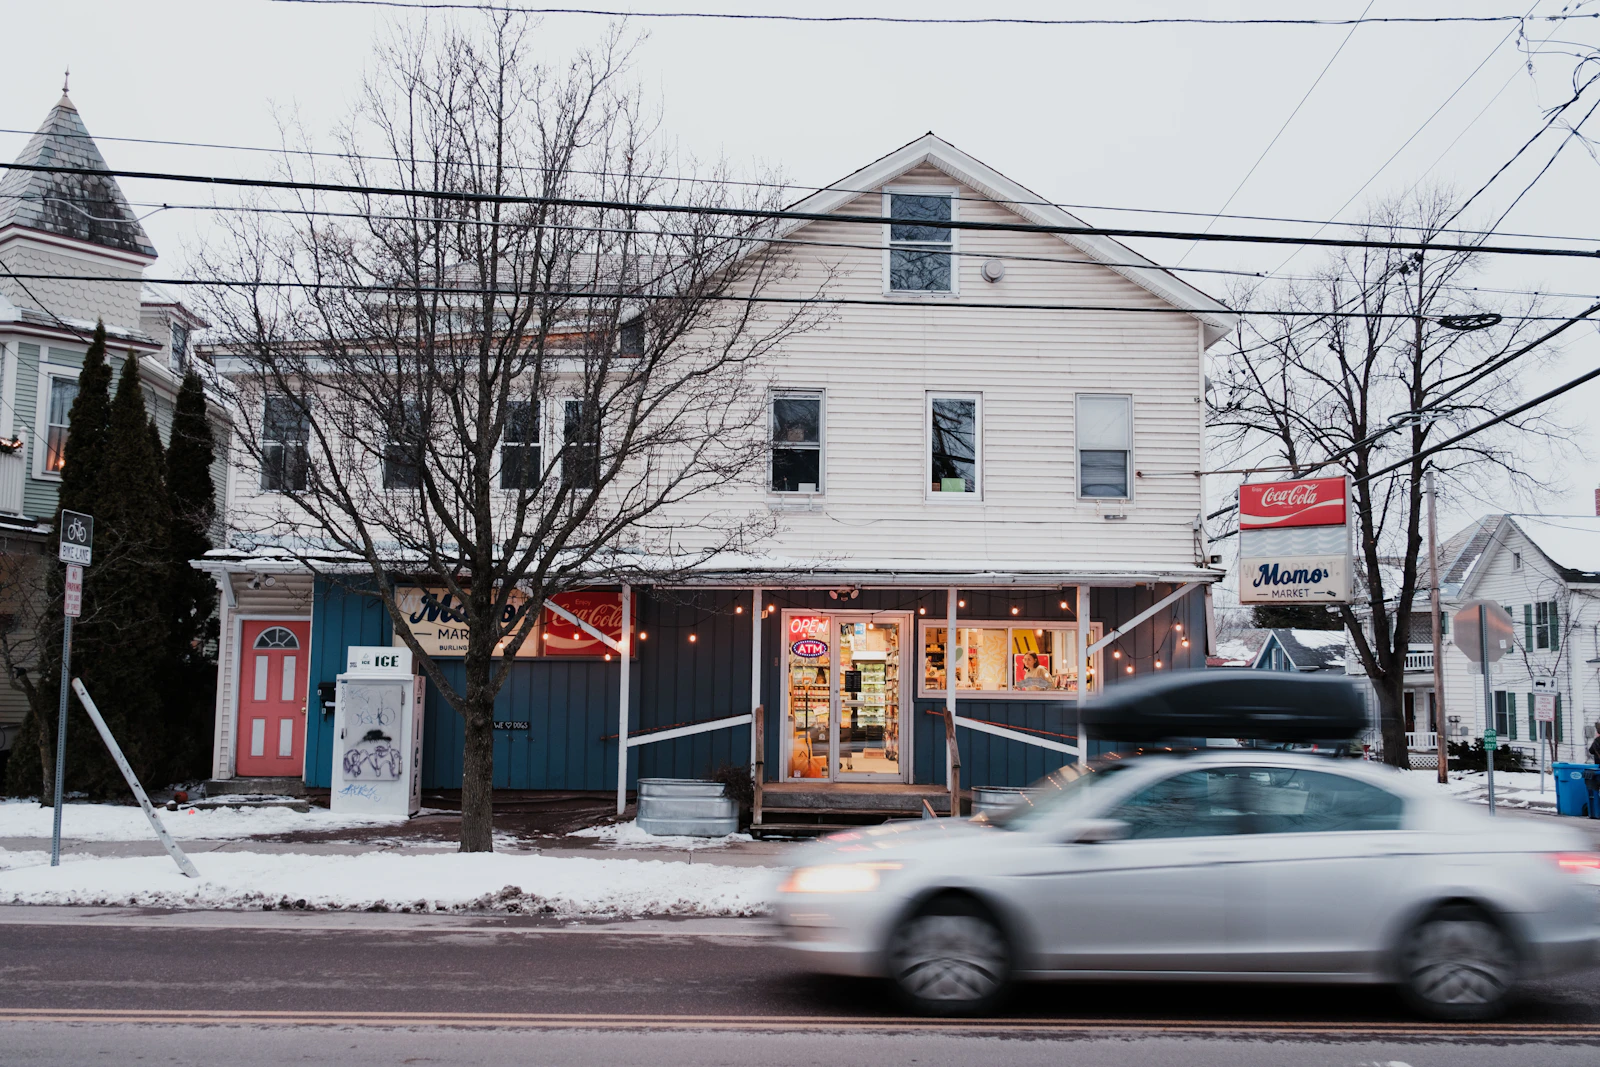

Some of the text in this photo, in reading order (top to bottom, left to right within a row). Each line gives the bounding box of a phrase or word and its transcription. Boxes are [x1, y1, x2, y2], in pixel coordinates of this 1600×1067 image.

[1261, 483, 1320, 507] Coca-Cola
[62, 545, 89, 561] BIKE LANE
[72, 571, 77, 581] NO
[66, 582, 81, 593] PARKING
[1272, 588, 1310, 599] MARKET
[575, 599, 592, 607] Enjoy
[790, 618, 829, 634] OPEN
[438, 628, 470, 640] MAR
[797, 643, 823, 655] ATM
[375, 655, 399, 668] ICE
[493, 721, 528, 729] WE DOGS
